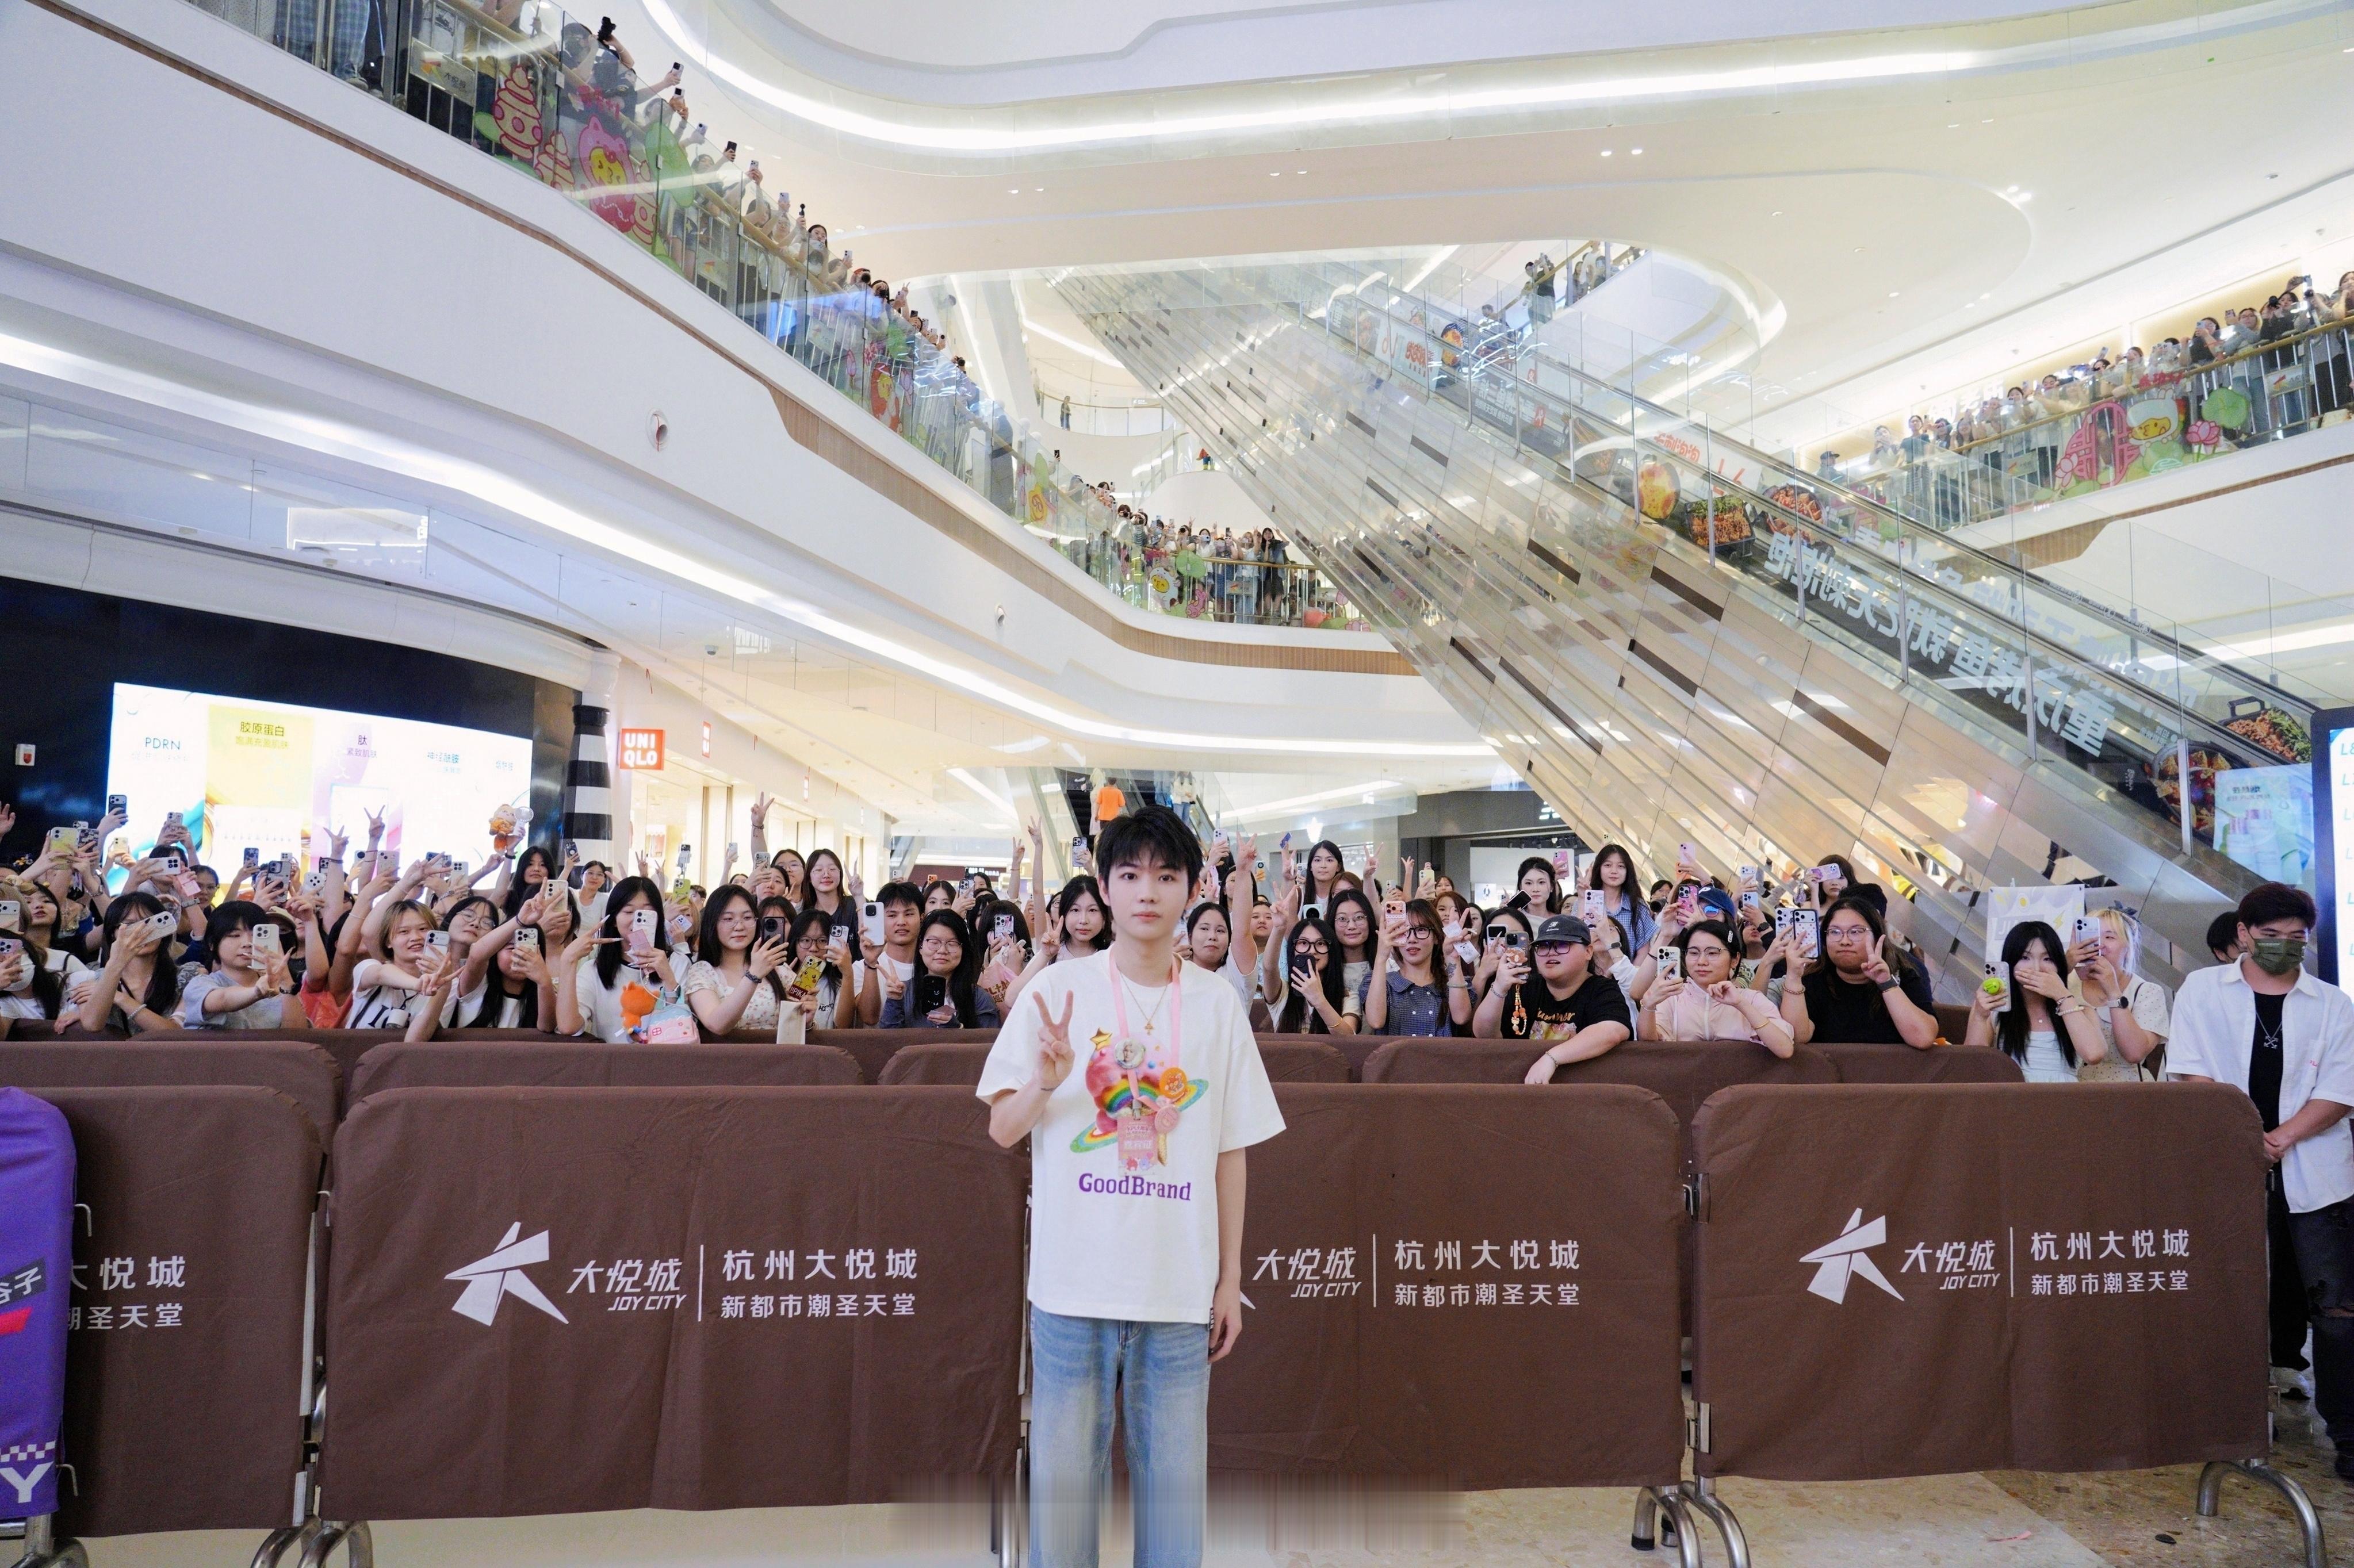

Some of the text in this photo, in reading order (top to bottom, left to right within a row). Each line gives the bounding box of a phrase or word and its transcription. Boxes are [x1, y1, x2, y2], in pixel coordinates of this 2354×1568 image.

[240, 721, 285, 737] 胶原蛋白
[358, 735, 368, 746] 肽
[624, 733, 656, 749] UNI
[145, 737, 181, 750] PDRN
[623, 750, 658, 768] QLO
[1079, 1173, 1191, 1201] GoodBrand
[1395, 1240, 1580, 1271] 杭州大悦城
[1901, 1240, 1996, 1273] 大悦城
[2031, 1229, 2190, 1261] 杭州大悦城
[567, 1259, 683, 1294] 大悦城
[722, 1248, 918, 1282] 杭州大悦城
[1253, 1247, 1357, 1281] 大悦城
[1291, 1281, 1362, 1298] JOY CITY
[1940, 1273, 2001, 1290] JOY CITY
[2031, 1270, 2188, 1296] 新都市潮圣天堂
[608, 1294, 687, 1312] JOY CITY
[721, 1293, 916, 1319] 新都市潮圣天堂
[1395, 1283, 1580, 1308] 新都市潮圣天堂
